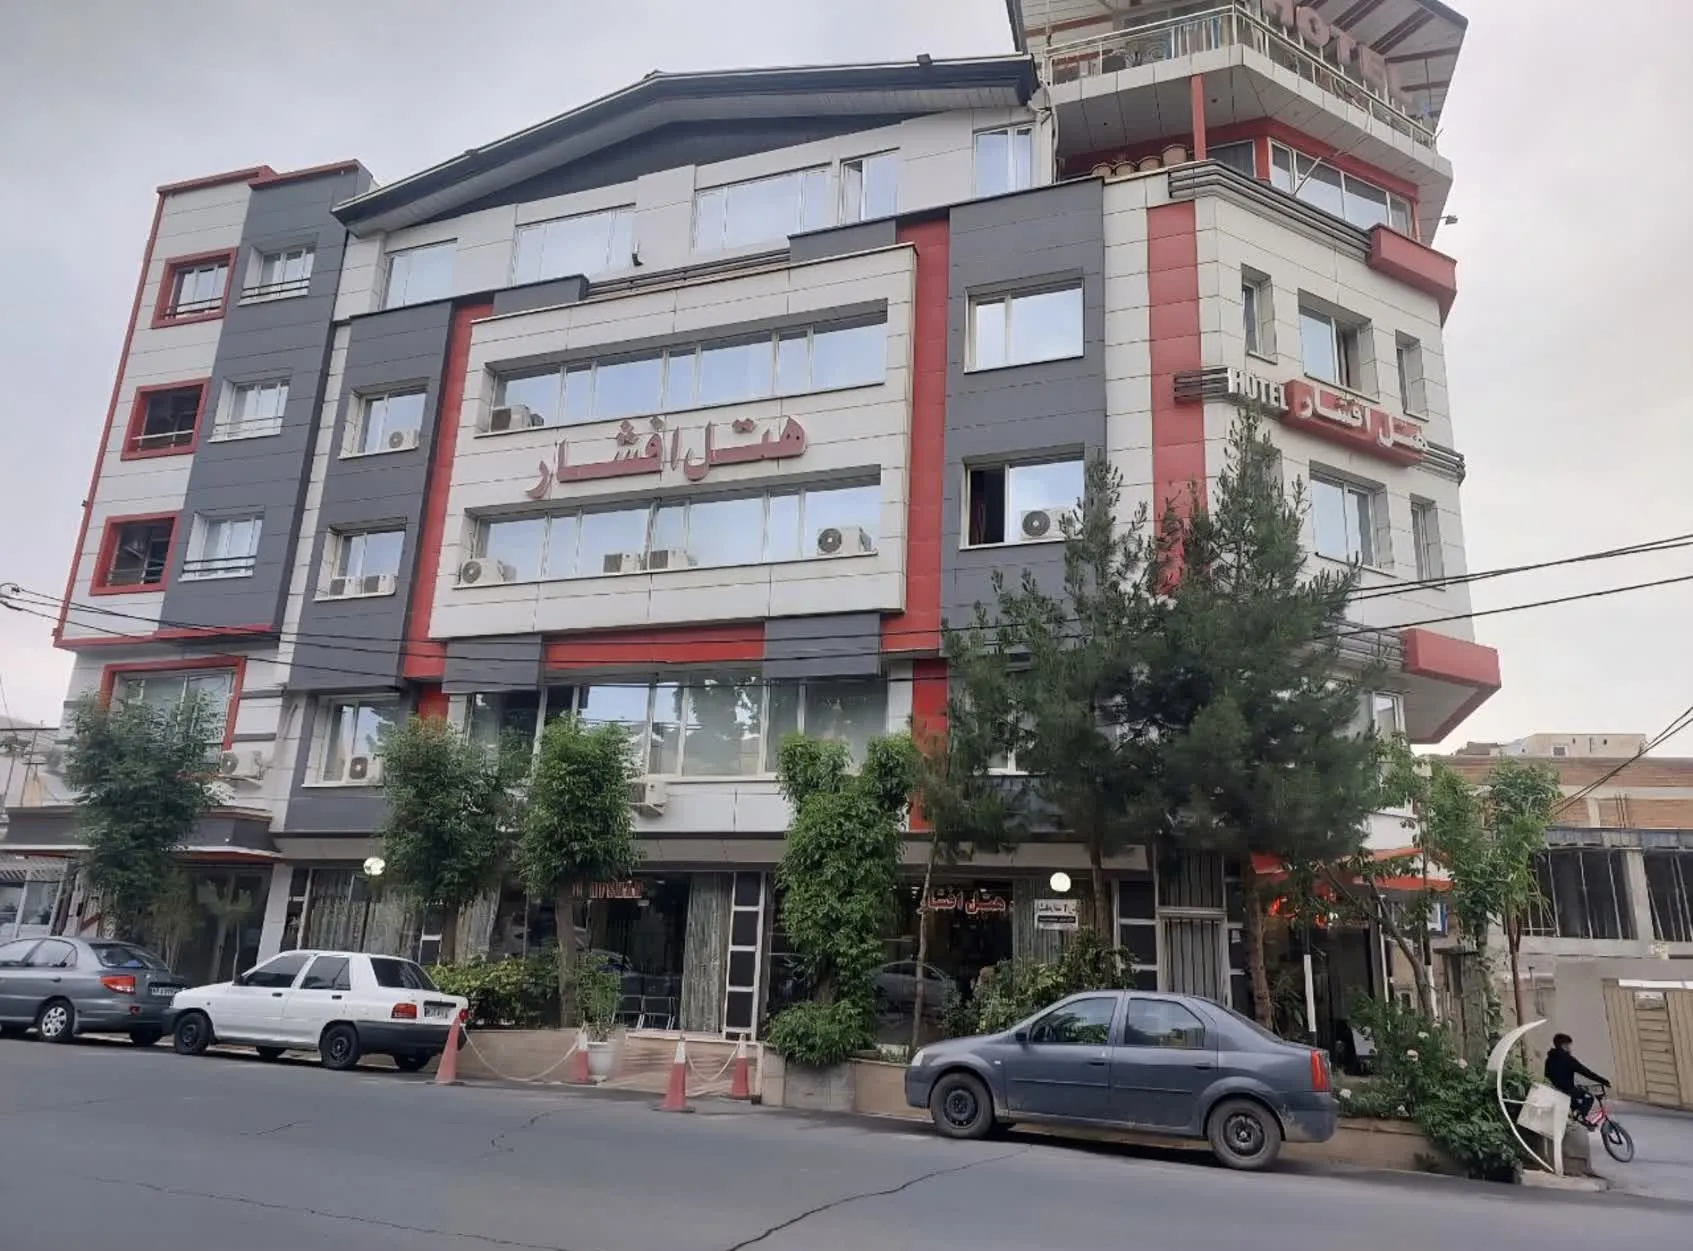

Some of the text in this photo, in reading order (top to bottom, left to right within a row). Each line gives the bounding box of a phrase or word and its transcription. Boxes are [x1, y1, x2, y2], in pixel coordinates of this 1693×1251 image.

[1296, 380, 1428, 451] هتل افشار
[524, 414, 808, 499] هتل افشار
